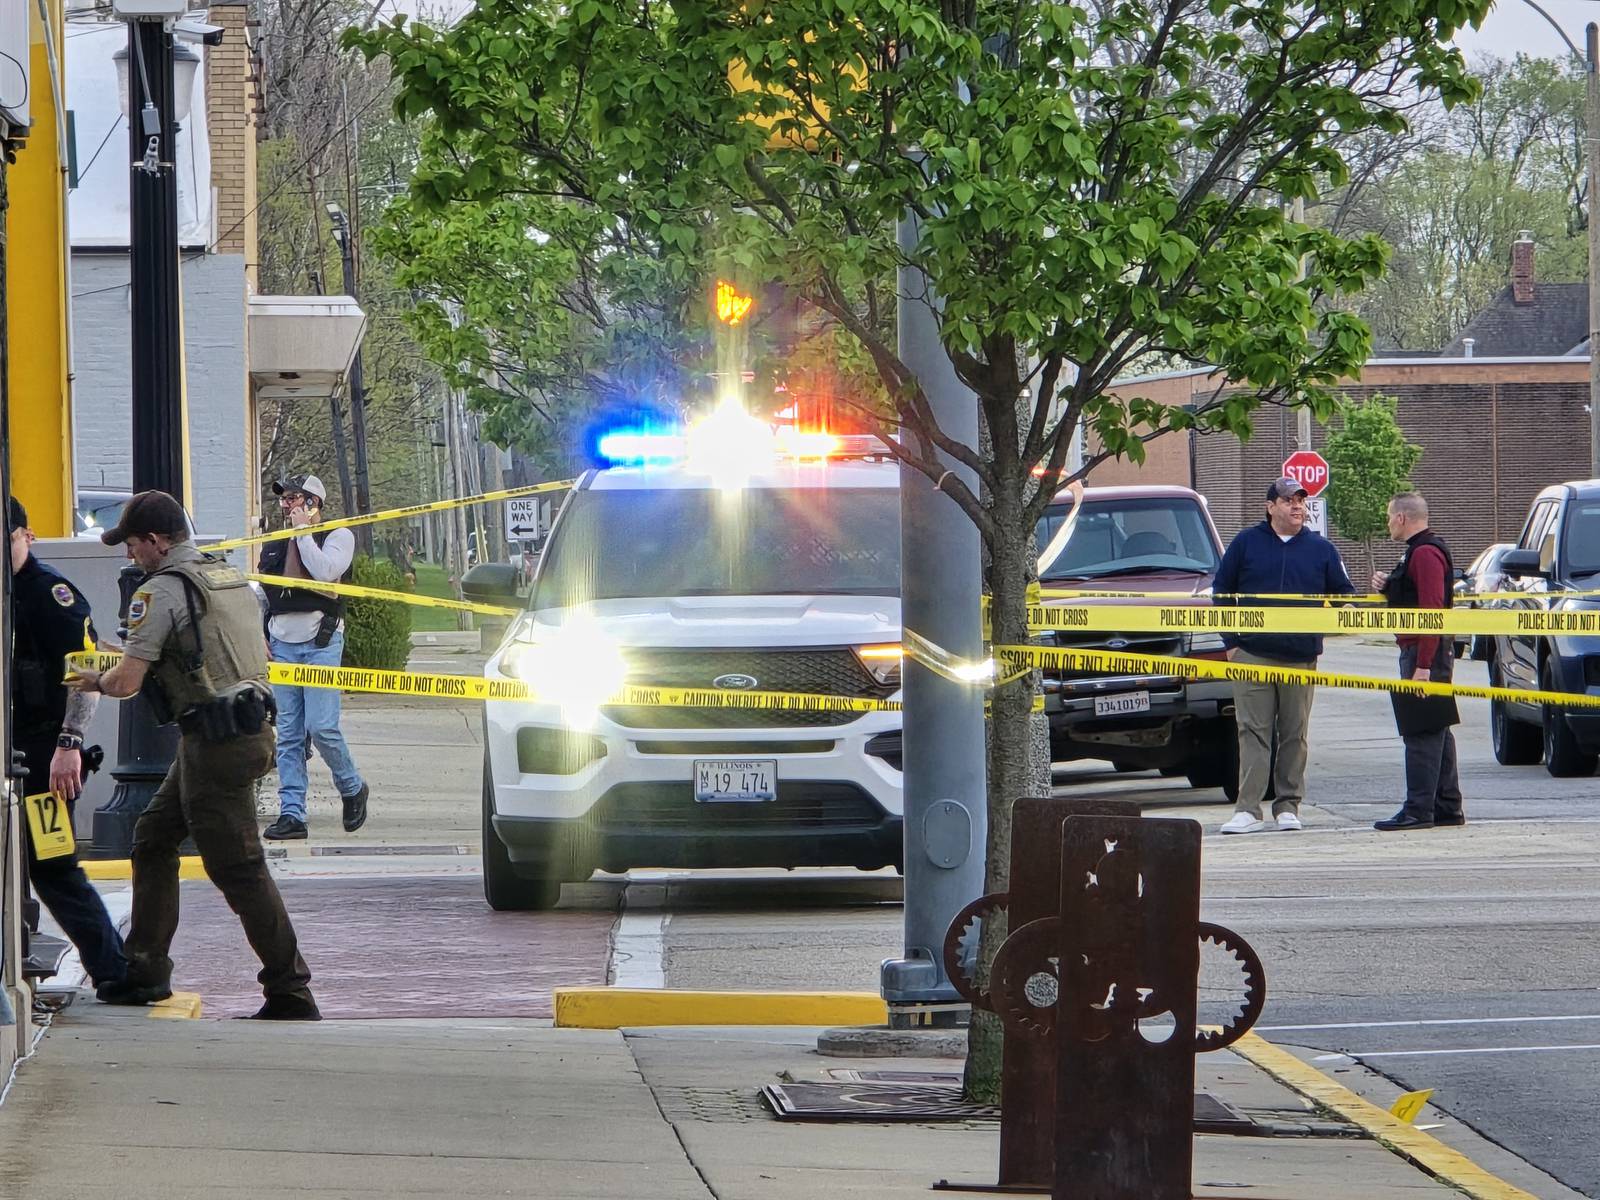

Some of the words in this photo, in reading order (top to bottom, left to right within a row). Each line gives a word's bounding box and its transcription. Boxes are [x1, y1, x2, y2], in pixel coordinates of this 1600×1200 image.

[1286, 466, 1325, 482] STOP
[511, 501, 532, 511] ONE
[1305, 501, 1320, 512] NE
[511, 512, 533, 522] WAY
[1305, 514, 1320, 524] AY
[1033, 608, 1042, 625] DO
[1045, 609, 1060, 626] NOT
[1063, 608, 1088, 626] CROSS
[1160, 609, 1186, 626] POLICE
[1189, 610, 1206, 627] LINE
[1208, 610, 1218, 627] DO
[1221, 610, 1236, 627] NOT
[1239, 611, 1265, 628] CROSS
[1338, 611, 1365, 628] POLICE
[1367, 612, 1384, 628] LINE
[1387, 612, 1396, 629] DO
[1399, 612, 1415, 629] NOT
[1418, 612, 1444, 629] CROSS
[1518, 613, 1544, 629] POLICE
[1547, 613, 1564, 630] LINE
[1566, 613, 1578, 630] DO
[1580, 614, 1596, 630] NOT
[1000, 650, 1034, 670] CROSS
[1040, 652, 1059, 669] NOT
[1062, 653, 1076, 670] DO
[1080, 655, 1103, 672] LINE
[1106, 656, 1149, 675] SHERIFF
[1152, 661, 1198, 679] CAUTION
[294, 667, 334, 686] CAUTION
[336, 670, 374, 689] SHERIFF
[376, 673, 397, 690] LINE
[400, 675, 412, 692] DO
[414, 676, 433, 693] NOT
[435, 678, 466, 695] CROSS
[630, 690, 660, 704] CROSS
[684, 692, 723, 706] CAUTION
[726, 694, 762, 708] SHERIFF
[765, 695, 785, 709] LINE
[788, 696, 800, 709] DO
[802, 697, 821, 710] NOT
[824, 698, 854, 711] CROSS
[714, 773, 731, 792] 19
[741, 773, 768, 792] 474
[34, 796, 62, 834] 12
